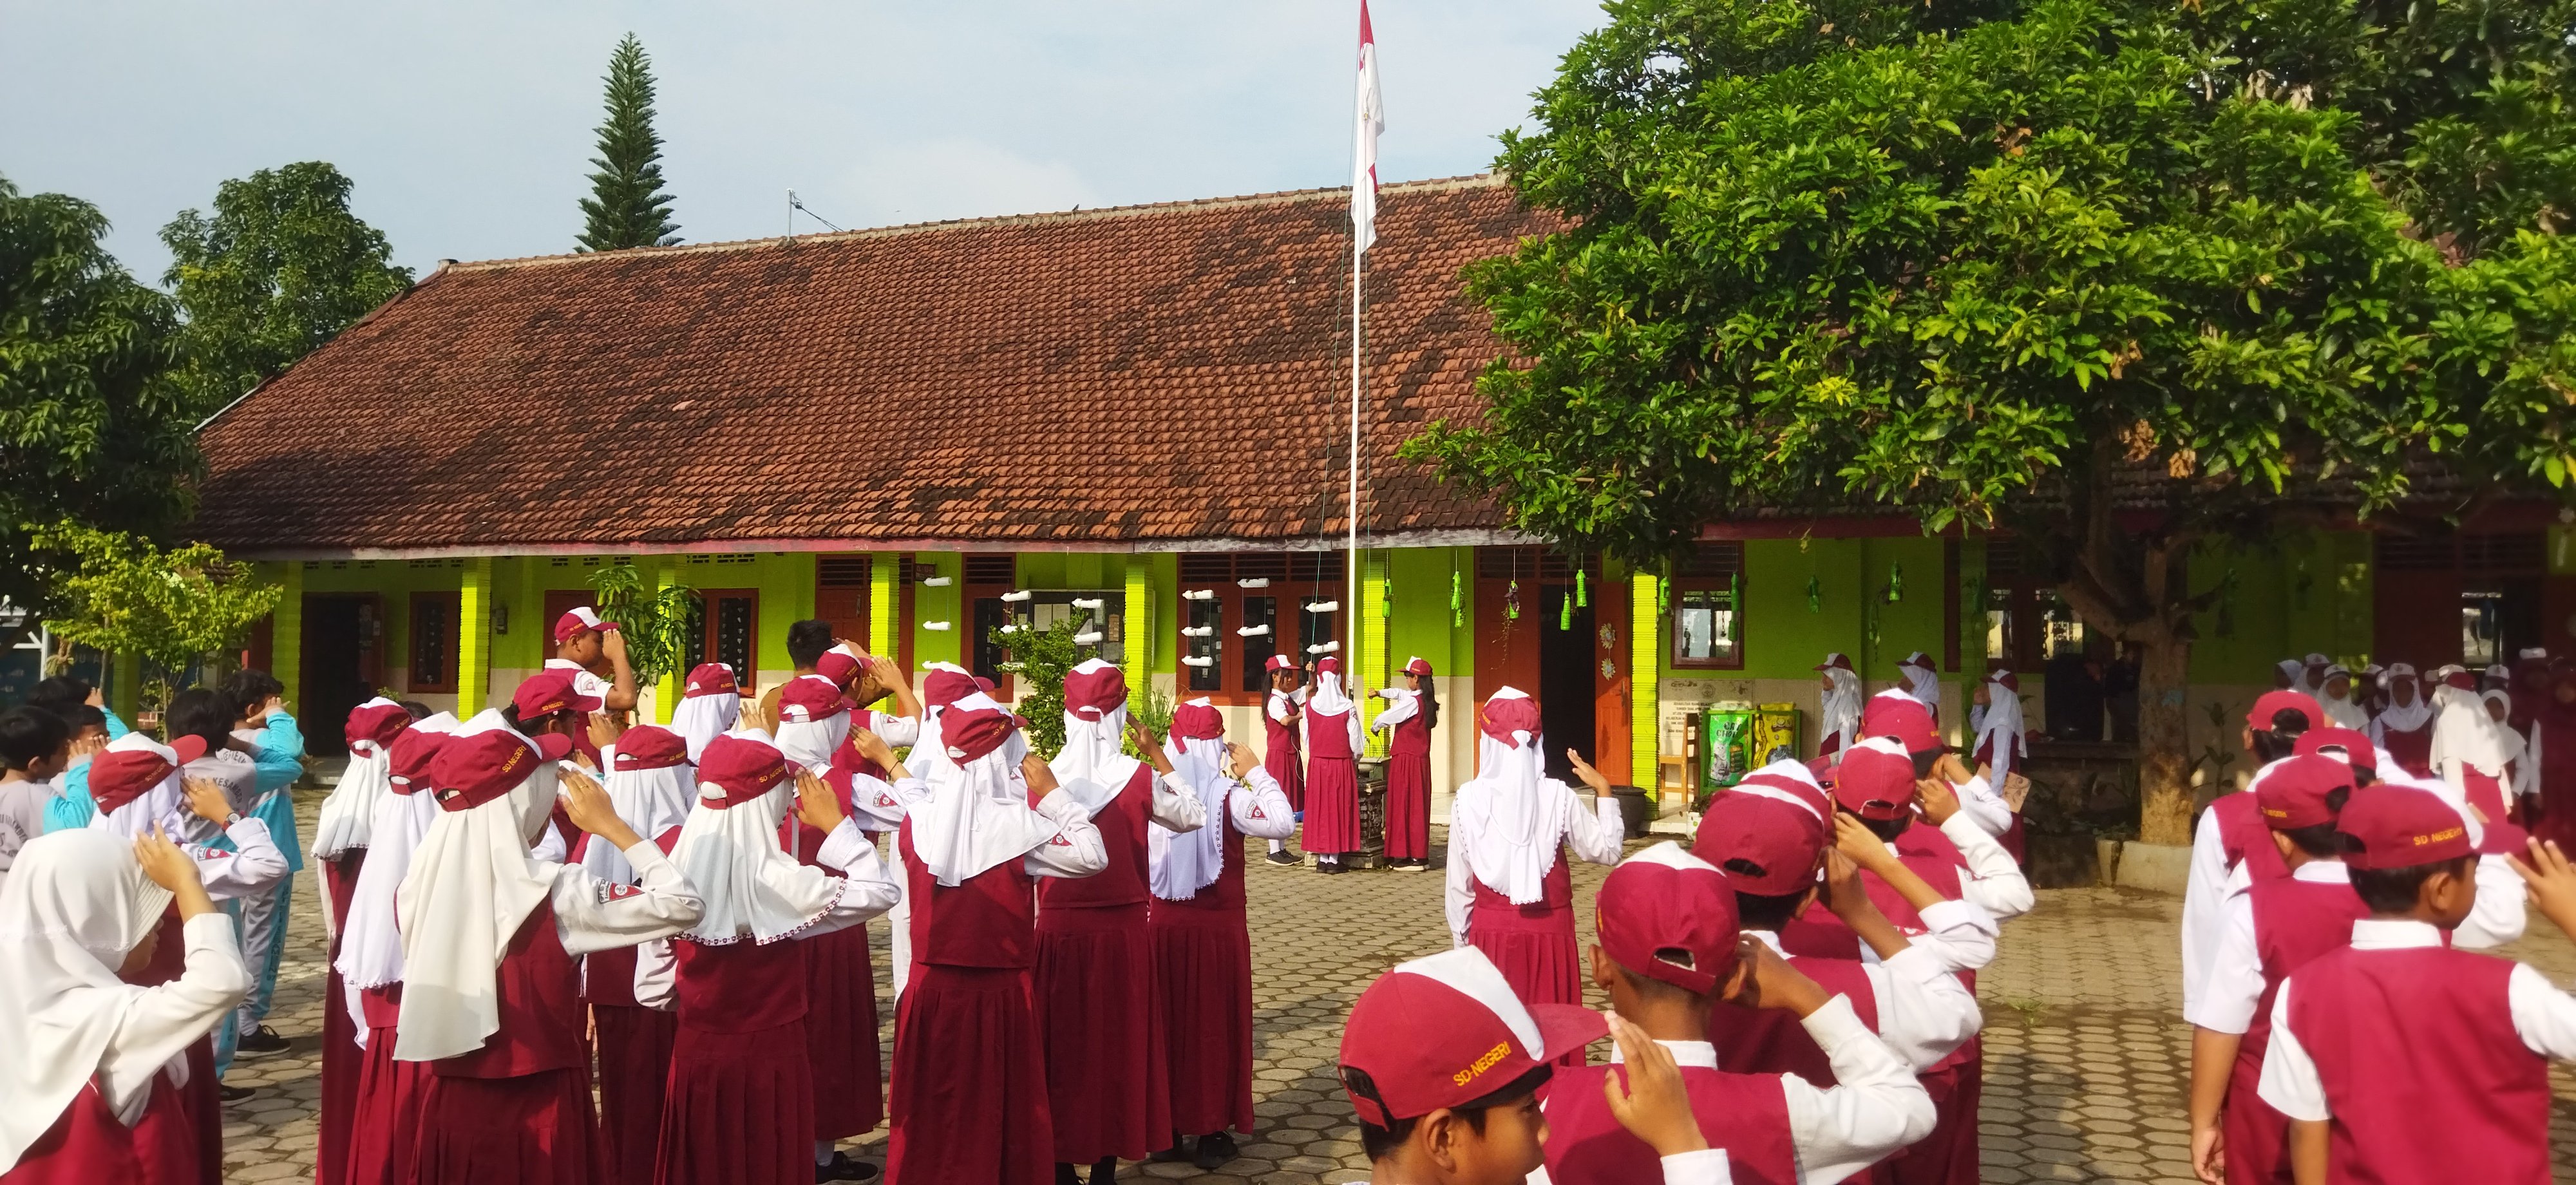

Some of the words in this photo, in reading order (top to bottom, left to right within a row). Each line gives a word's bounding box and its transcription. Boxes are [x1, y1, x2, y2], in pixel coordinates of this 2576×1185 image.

[502, 763, 511, 772] SD
[508, 744, 527, 766] NEGERI
[2413, 835, 2429, 846] SD
